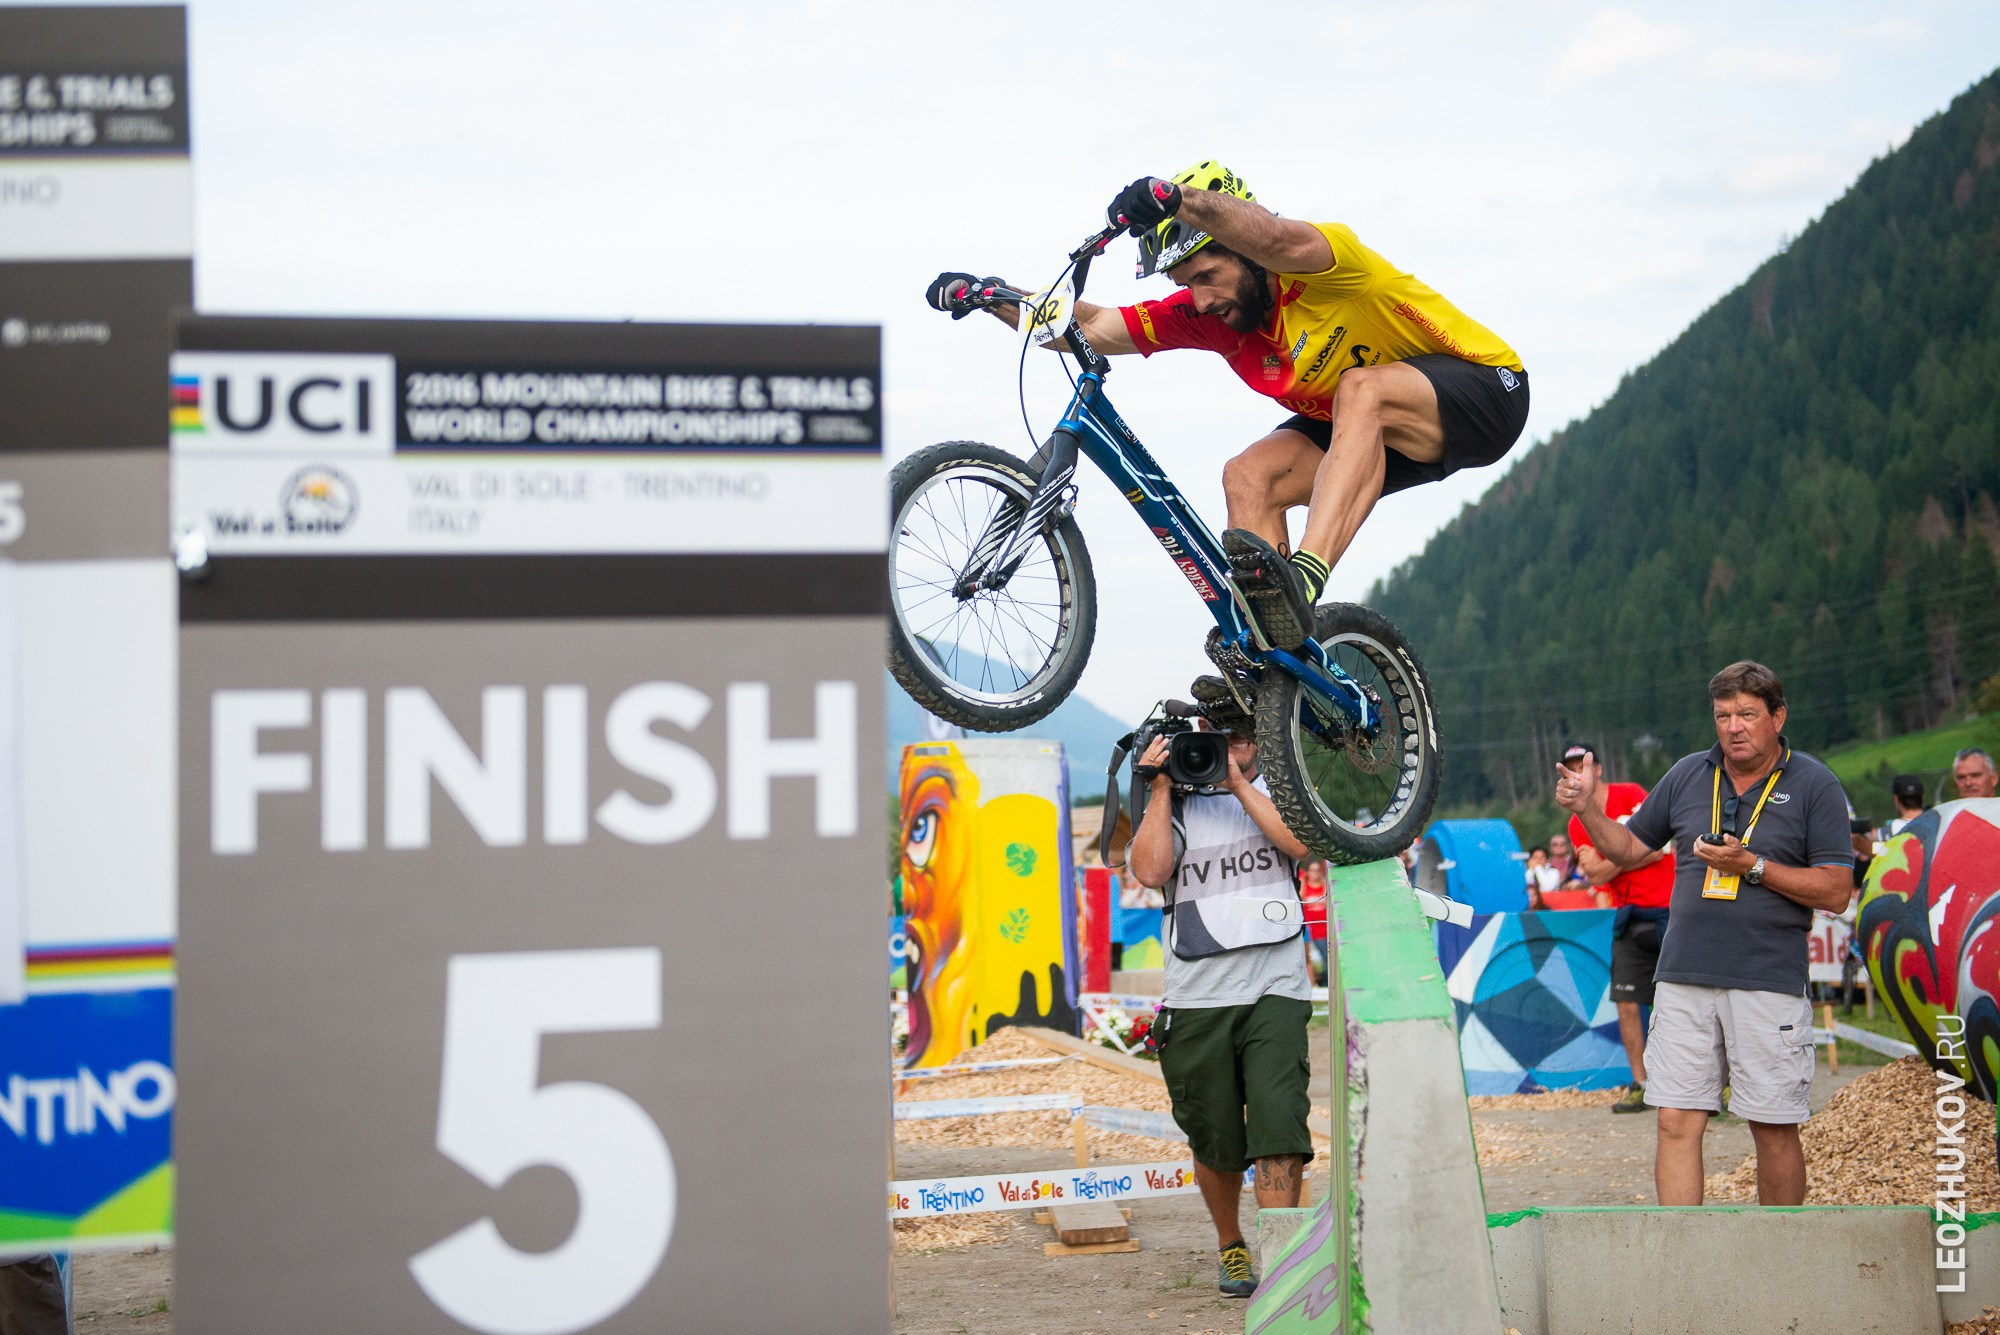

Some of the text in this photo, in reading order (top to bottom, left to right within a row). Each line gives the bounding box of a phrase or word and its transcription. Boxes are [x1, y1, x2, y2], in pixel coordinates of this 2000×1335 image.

[58, 74, 175, 109] TRIALS
[215, 376, 370, 434] UCI
[406, 374, 873, 411] 2016 MOUNTAIN BIKE & TRIALS
[405, 408, 532, 442] WORLD
[534, 409, 803, 444] CHAMPIONSHIPS
[407, 471, 459, 499] VAL
[471, 471, 504, 499] DI
[512, 472, 588, 500] SOLE
[625, 472, 770, 500] TRENTINO
[407, 508, 484, 535] ITALY
[211, 680, 858, 854] FINISH
[1181, 846, 1285, 886] TV HOST
[408, 946, 677, 1335] 5
[919, 1184, 984, 1211] TRENTINO
[998, 1181, 1020, 1203] Val
[1021, 1188, 1031, 1201] di
[1032, 1179, 1063, 1200] Sole
[1072, 1174, 1132, 1199] TRENTINO
[1144, 1169, 1165, 1191] Val
[1166, 1177, 1176, 1190] di
[1176, 1167, 1199, 1188] Sol
